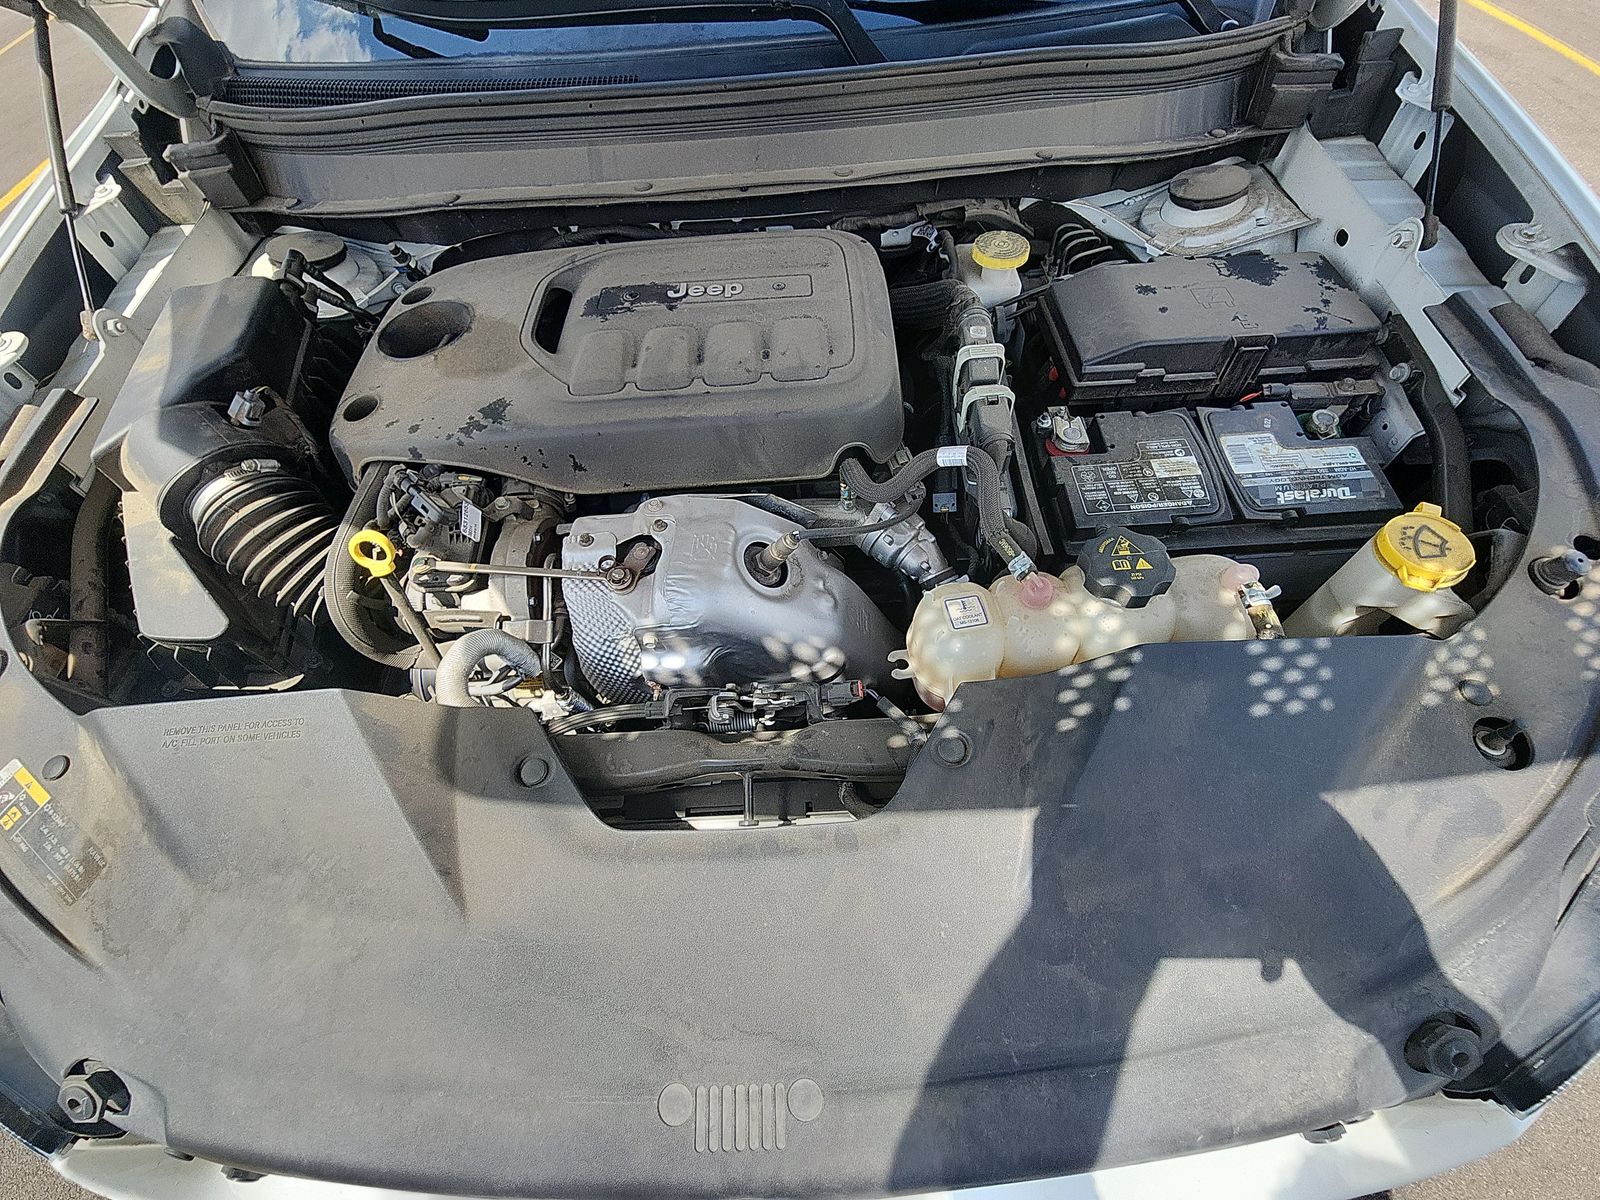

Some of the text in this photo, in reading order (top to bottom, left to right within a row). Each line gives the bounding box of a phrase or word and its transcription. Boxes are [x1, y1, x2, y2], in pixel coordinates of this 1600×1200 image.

[667, 282, 744, 298] Jeep
[1269, 475, 1323, 485] TECHNOLOGY
[1274, 481, 1327, 491] PLATINUM
[1275, 486, 1357, 505] Duralast
[1130, 501, 1188, 510] DANGER/POISON
[163, 717, 305, 737] REMOVE THIS PANEL FOR ACCESS TO
[162, 730, 302, 749] A/C FILL PORT ON SOME VEHICLES
